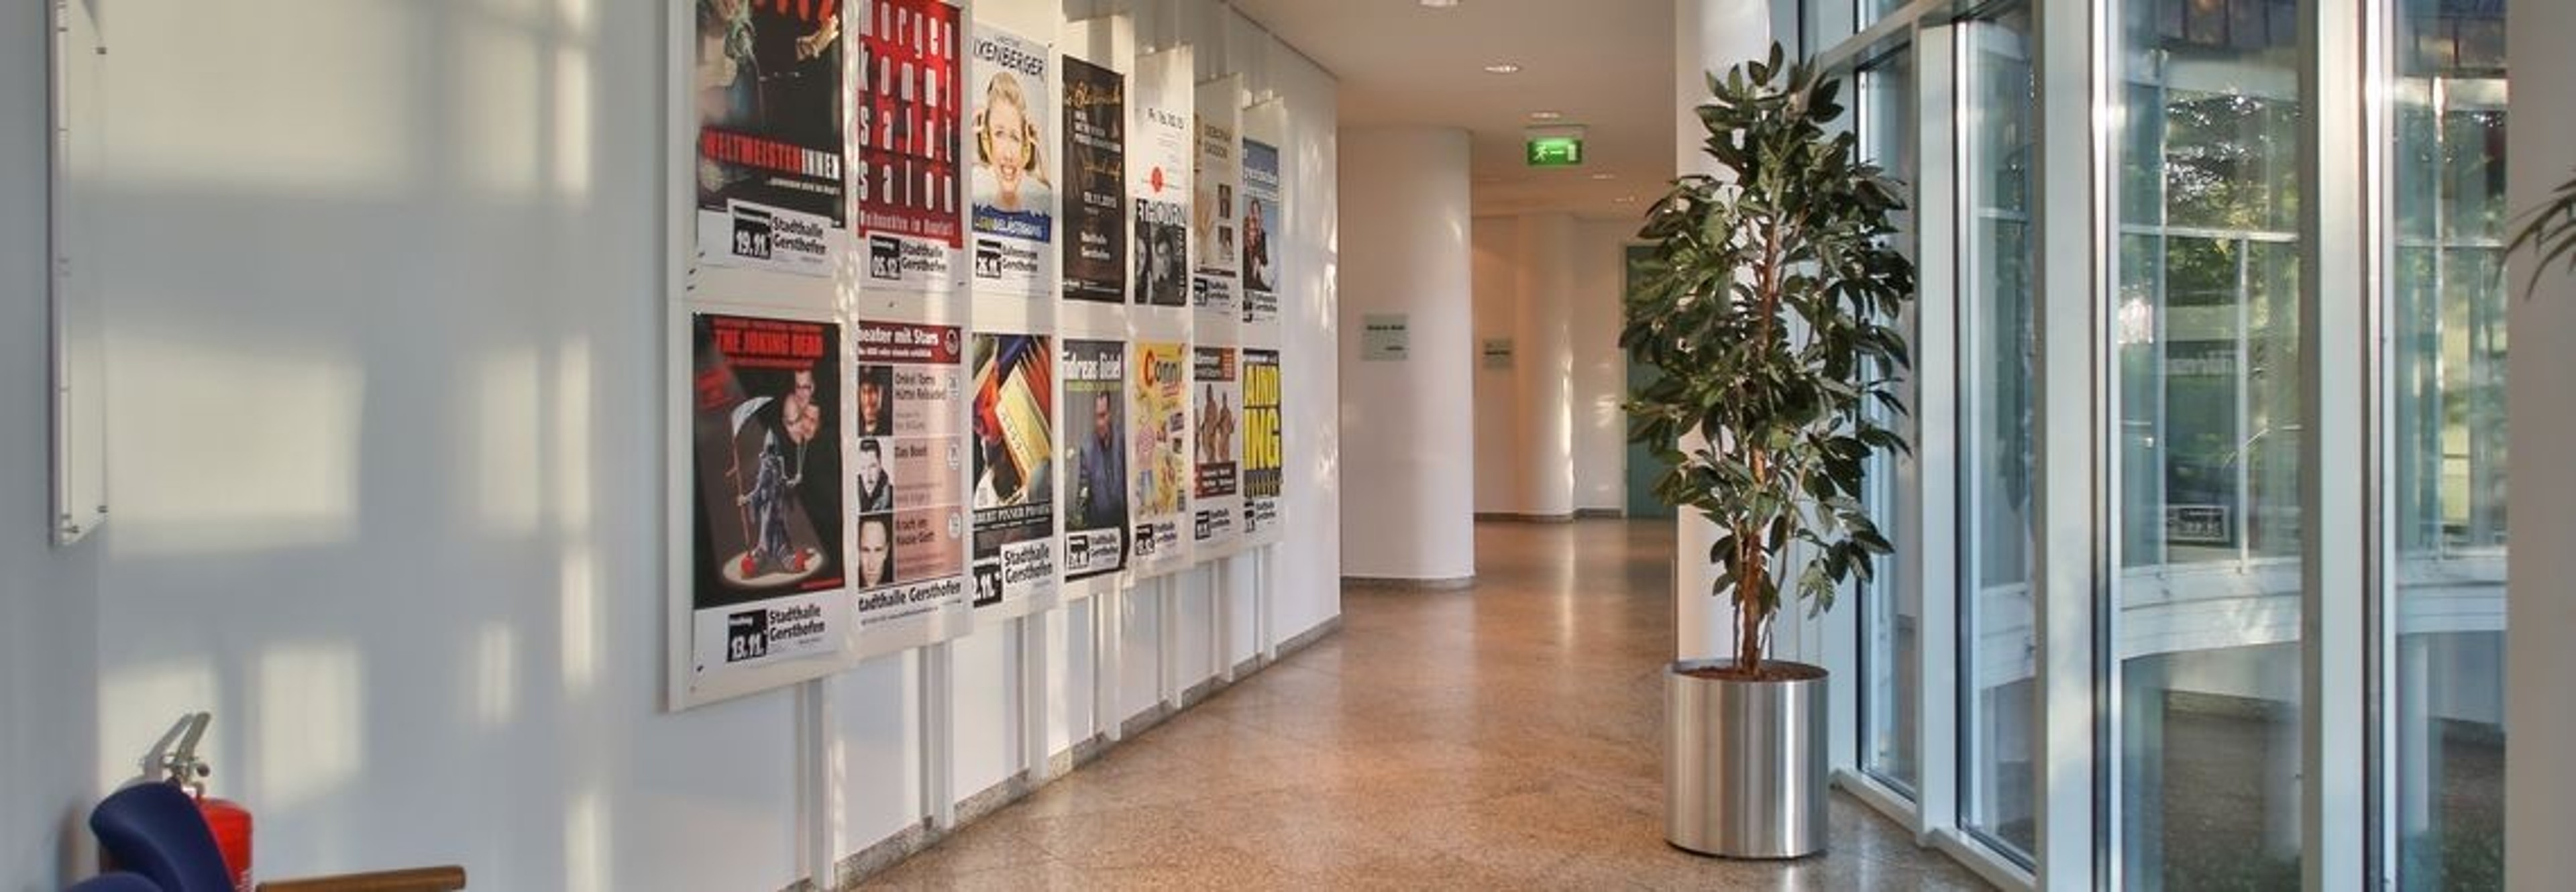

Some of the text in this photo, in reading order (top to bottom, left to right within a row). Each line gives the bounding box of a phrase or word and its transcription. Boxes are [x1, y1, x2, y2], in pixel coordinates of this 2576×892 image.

[773, 216, 823, 239] Stadthalle
[773, 233, 826, 255] Gersthofen
[1005, 543, 1050, 566] Stadthalle
[1006, 562, 1053, 583] Gersthofen
[908, 580, 962, 602] Gersthofen
[769, 604, 821, 625] Stadthalle
[770, 620, 825, 641] Gersthofen
